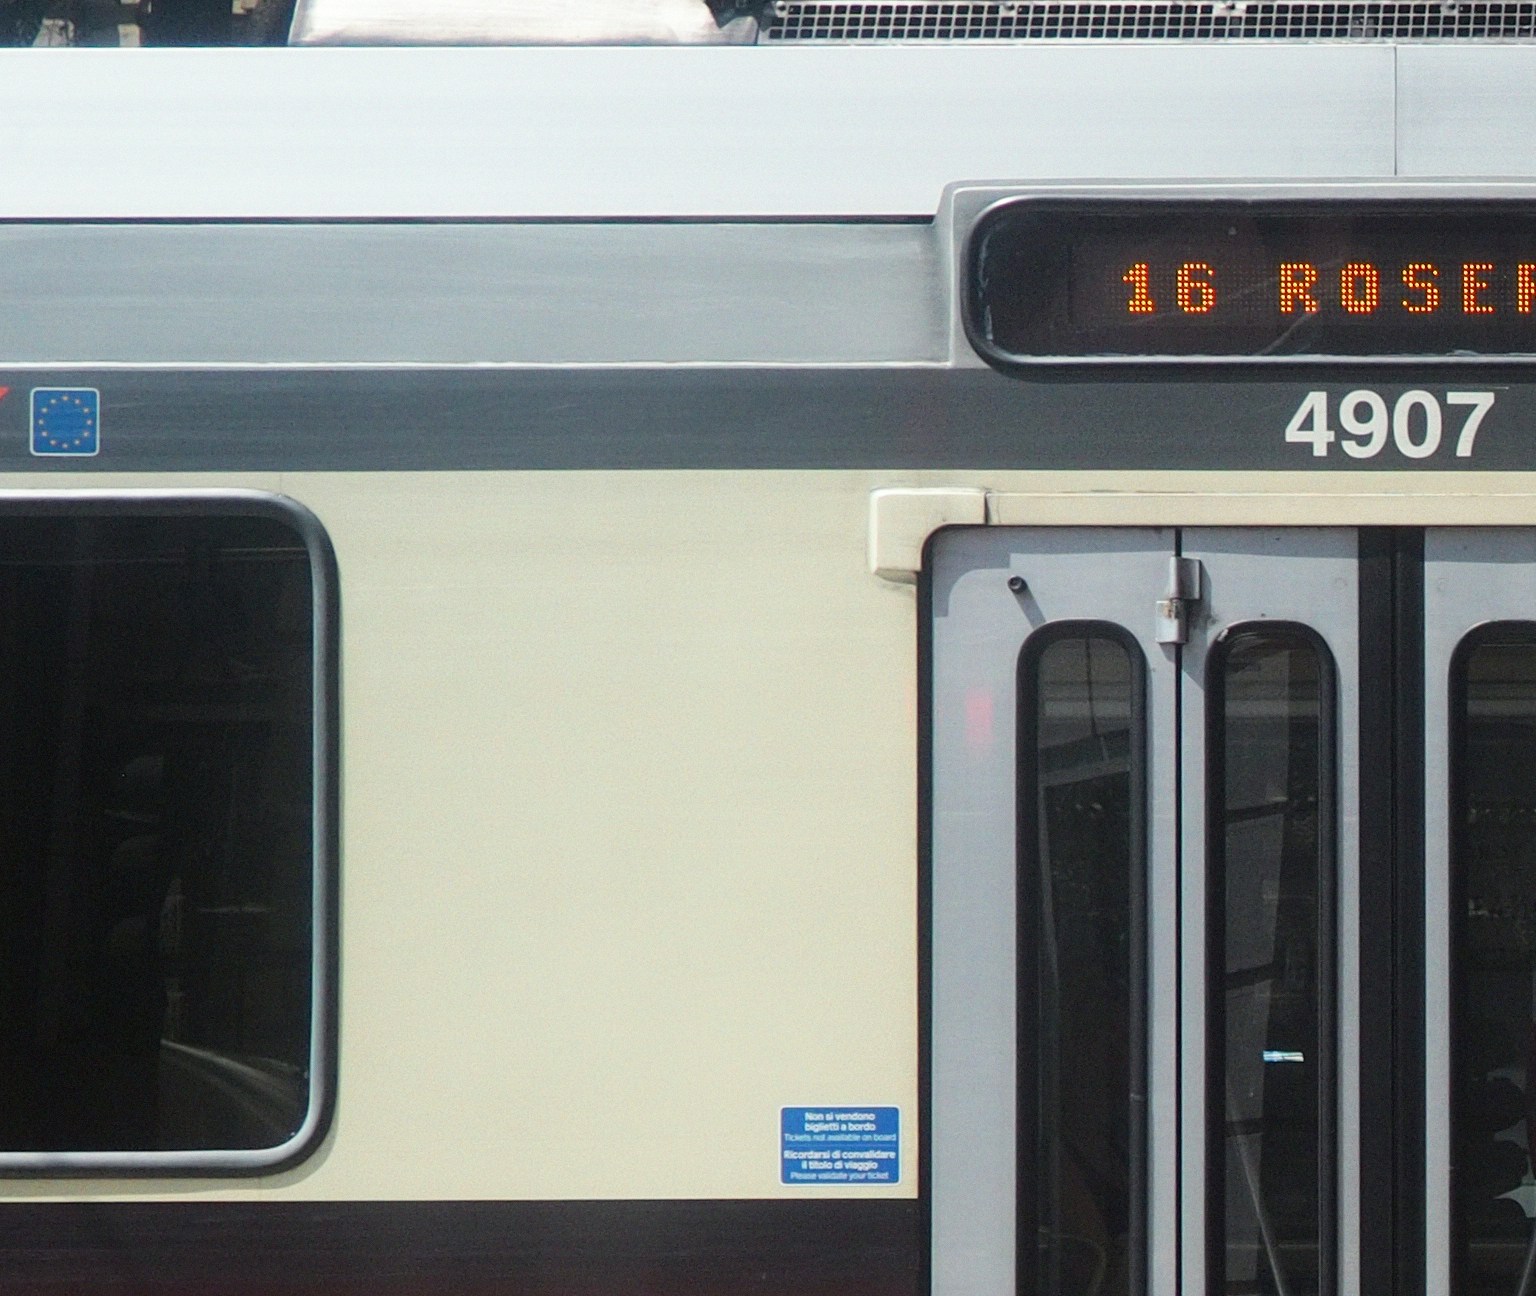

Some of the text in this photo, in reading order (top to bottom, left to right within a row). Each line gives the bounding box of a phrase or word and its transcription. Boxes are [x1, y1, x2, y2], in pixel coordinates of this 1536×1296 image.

[1121, 262, 1218, 314] 16
[1285, 390, 1495, 459] 4907
[805, 1112, 876, 1121] Non si vendono
[804, 1122, 839, 1132] biglietti
[848, 1122, 877, 1131] bordo
[783, 1150, 896, 1159] Ricordarsi di convalidare
[808, 1160, 833, 1169] titolo
[834, 1160, 843, 1169] di
[845, 1160, 878, 1171] viaggio
